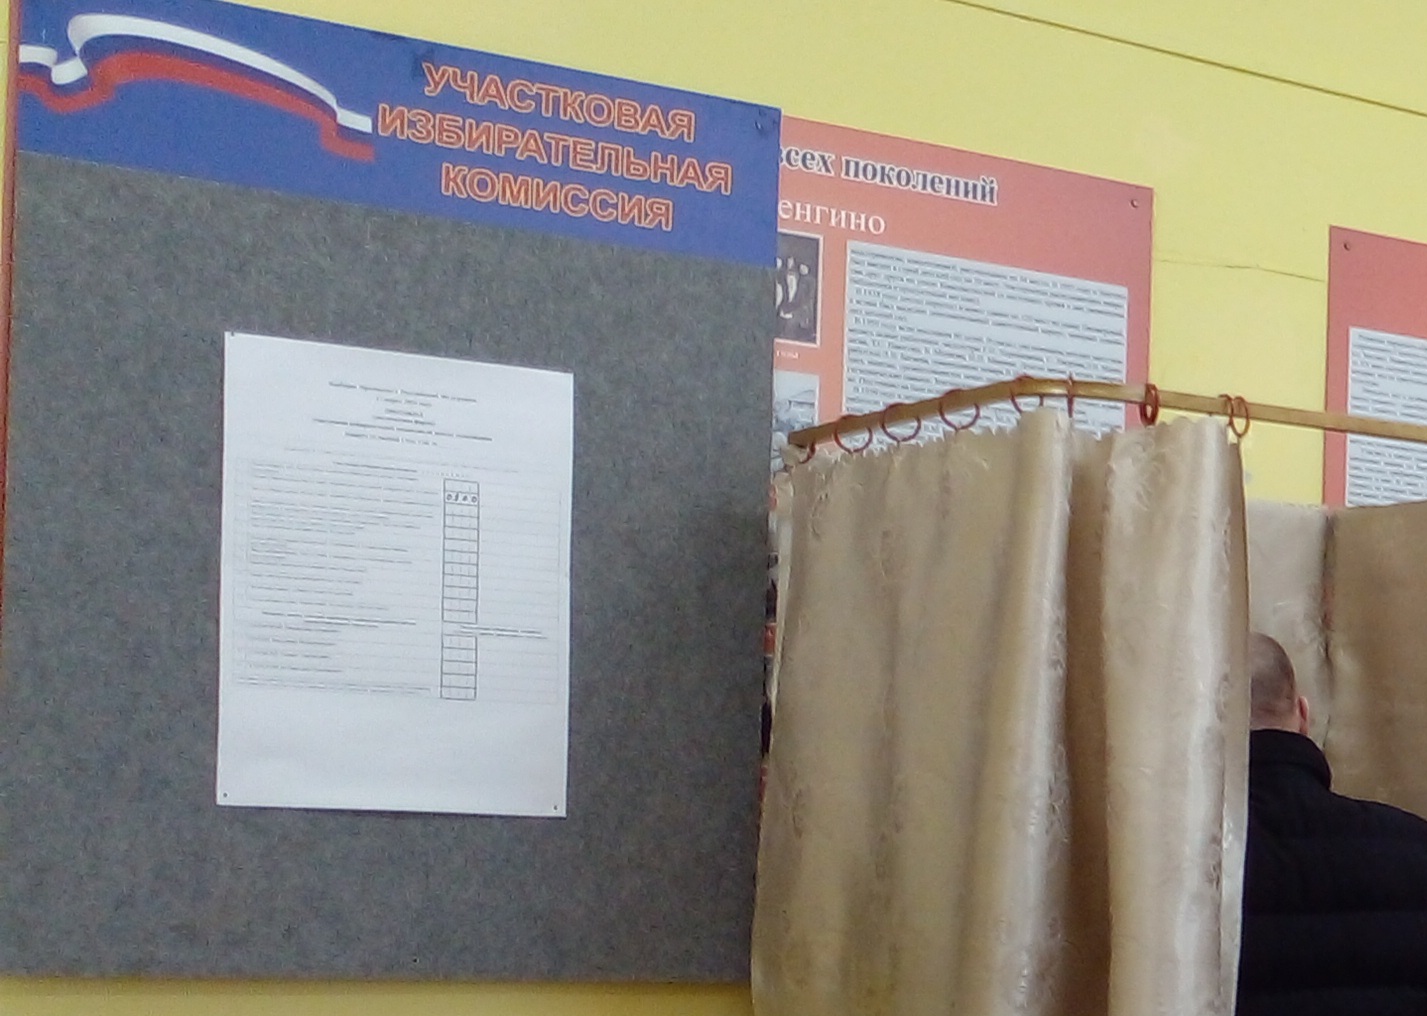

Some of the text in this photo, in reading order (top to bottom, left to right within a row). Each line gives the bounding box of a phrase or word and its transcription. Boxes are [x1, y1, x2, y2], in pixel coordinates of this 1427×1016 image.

[422, 62, 695, 142] УЧАСТКОВАЯ
[378, 105, 732, 195] ИЗБИРАТЕЛЬНАЯ
[841, 156, 998, 206] поколений
[441, 162, 674, 231] КОМИССИЯ
[778, 199, 886, 235] енгино
